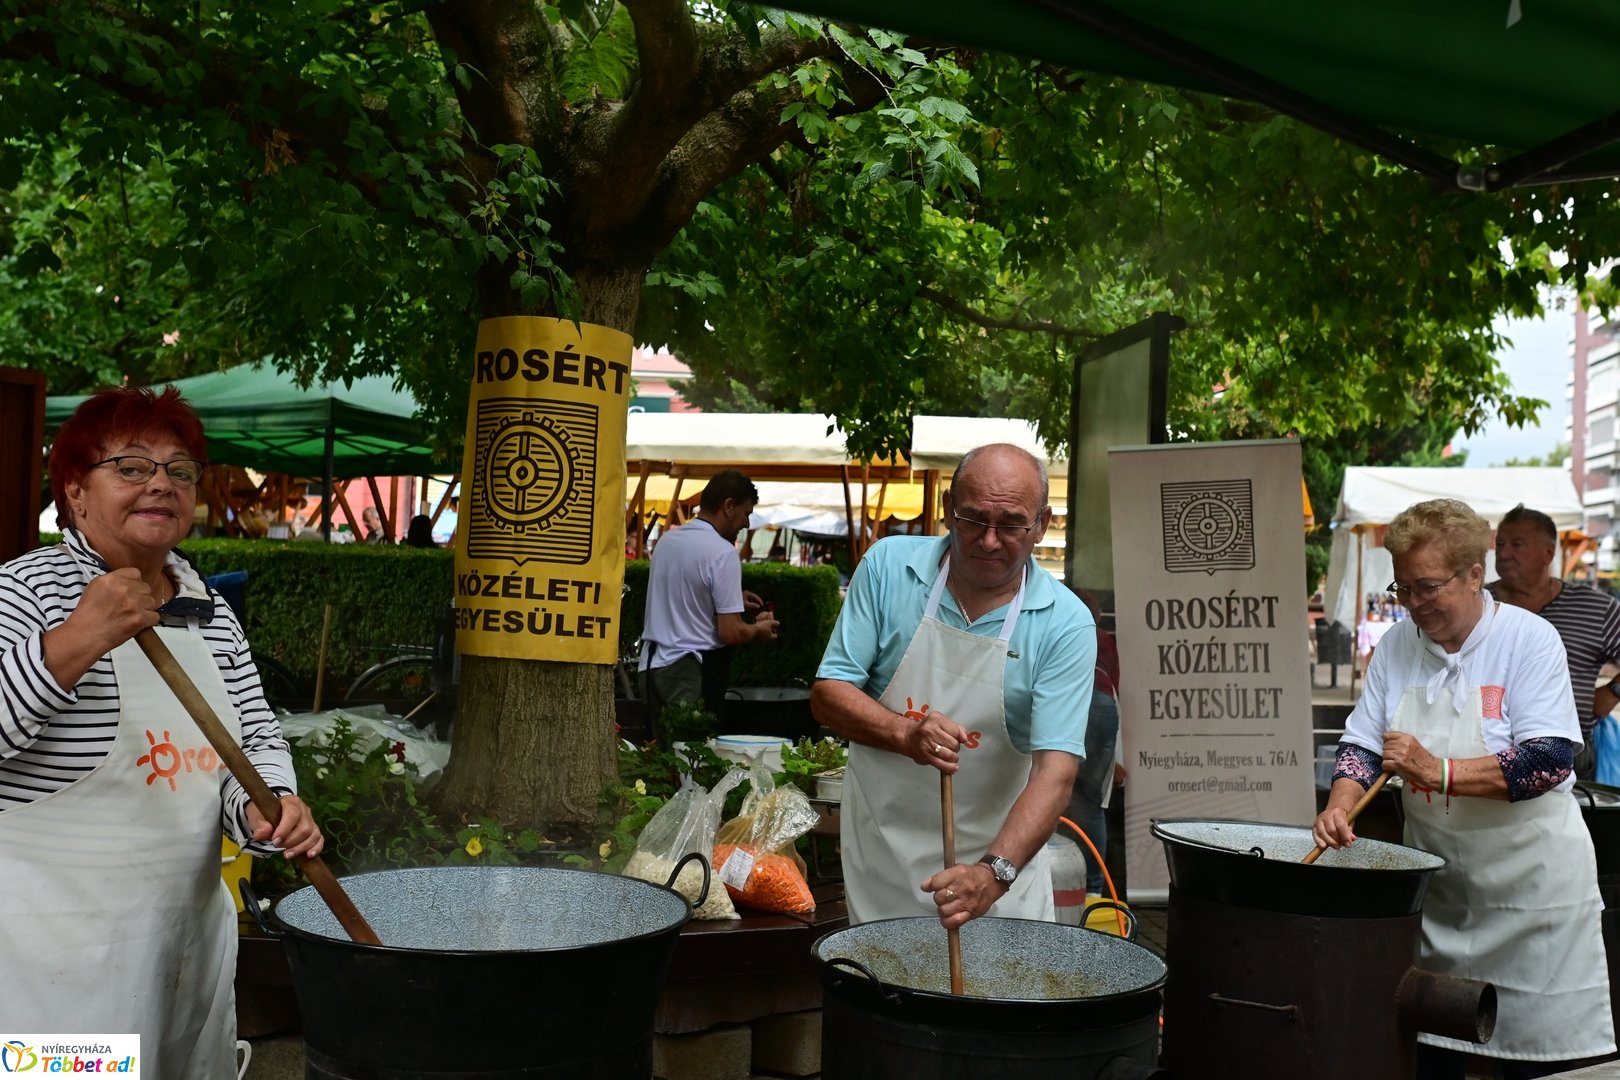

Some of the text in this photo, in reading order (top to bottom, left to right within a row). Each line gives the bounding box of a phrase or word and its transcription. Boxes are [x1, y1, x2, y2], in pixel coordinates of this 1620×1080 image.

[472, 344, 628, 395] ROSÉRT
[458, 569, 601, 604] KÖZÉLETI
[455, 607, 611, 639] EGYESÜLET
[1145, 589, 1279, 631] OROSÉRT
[1158, 636, 1271, 675] KÖZÉLETI
[1149, 683, 1283, 720] EGYESÜLET
[150, 741, 228, 779] Oro
[1207, 750, 1253, 769] Meggyes
[1256, 754, 1266, 767] u.
[1269, 750, 1298, 767] 76/A
[1168, 776, 1272, 794] orosert@gmail.com
